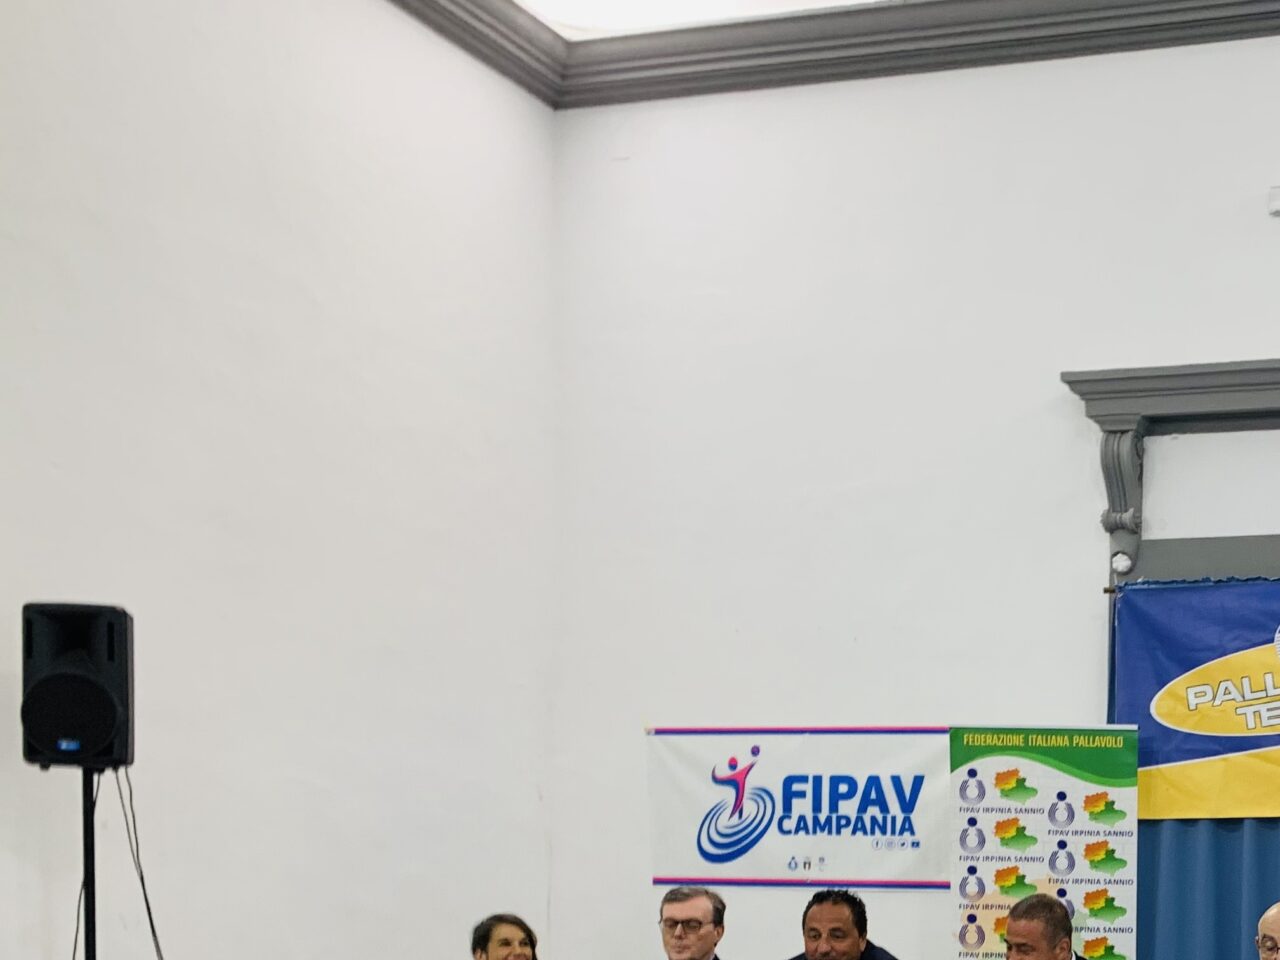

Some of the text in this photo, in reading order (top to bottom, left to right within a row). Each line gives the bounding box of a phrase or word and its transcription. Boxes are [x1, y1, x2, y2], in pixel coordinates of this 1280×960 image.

[963, 732, 1124, 748] FEDERAZIONE ITALIANA PALLAVOLO
[781, 774, 925, 815] FIPAV
[959, 806, 1045, 815] FIPAV IRPINIA SANNIO
[777, 814, 916, 836] CAMPANIA
[1048, 829, 1070, 837] FIPAV
[1102, 830, 1134, 838] SANNIO
[959, 855, 981, 863] FIPAV
[1072, 878, 1101, 886] IRPINIA
[959, 903, 980, 911] FIPAV
[1072, 926, 1134, 934] RPINIA SANNIO
[958, 951, 980, 959] FIPAV
